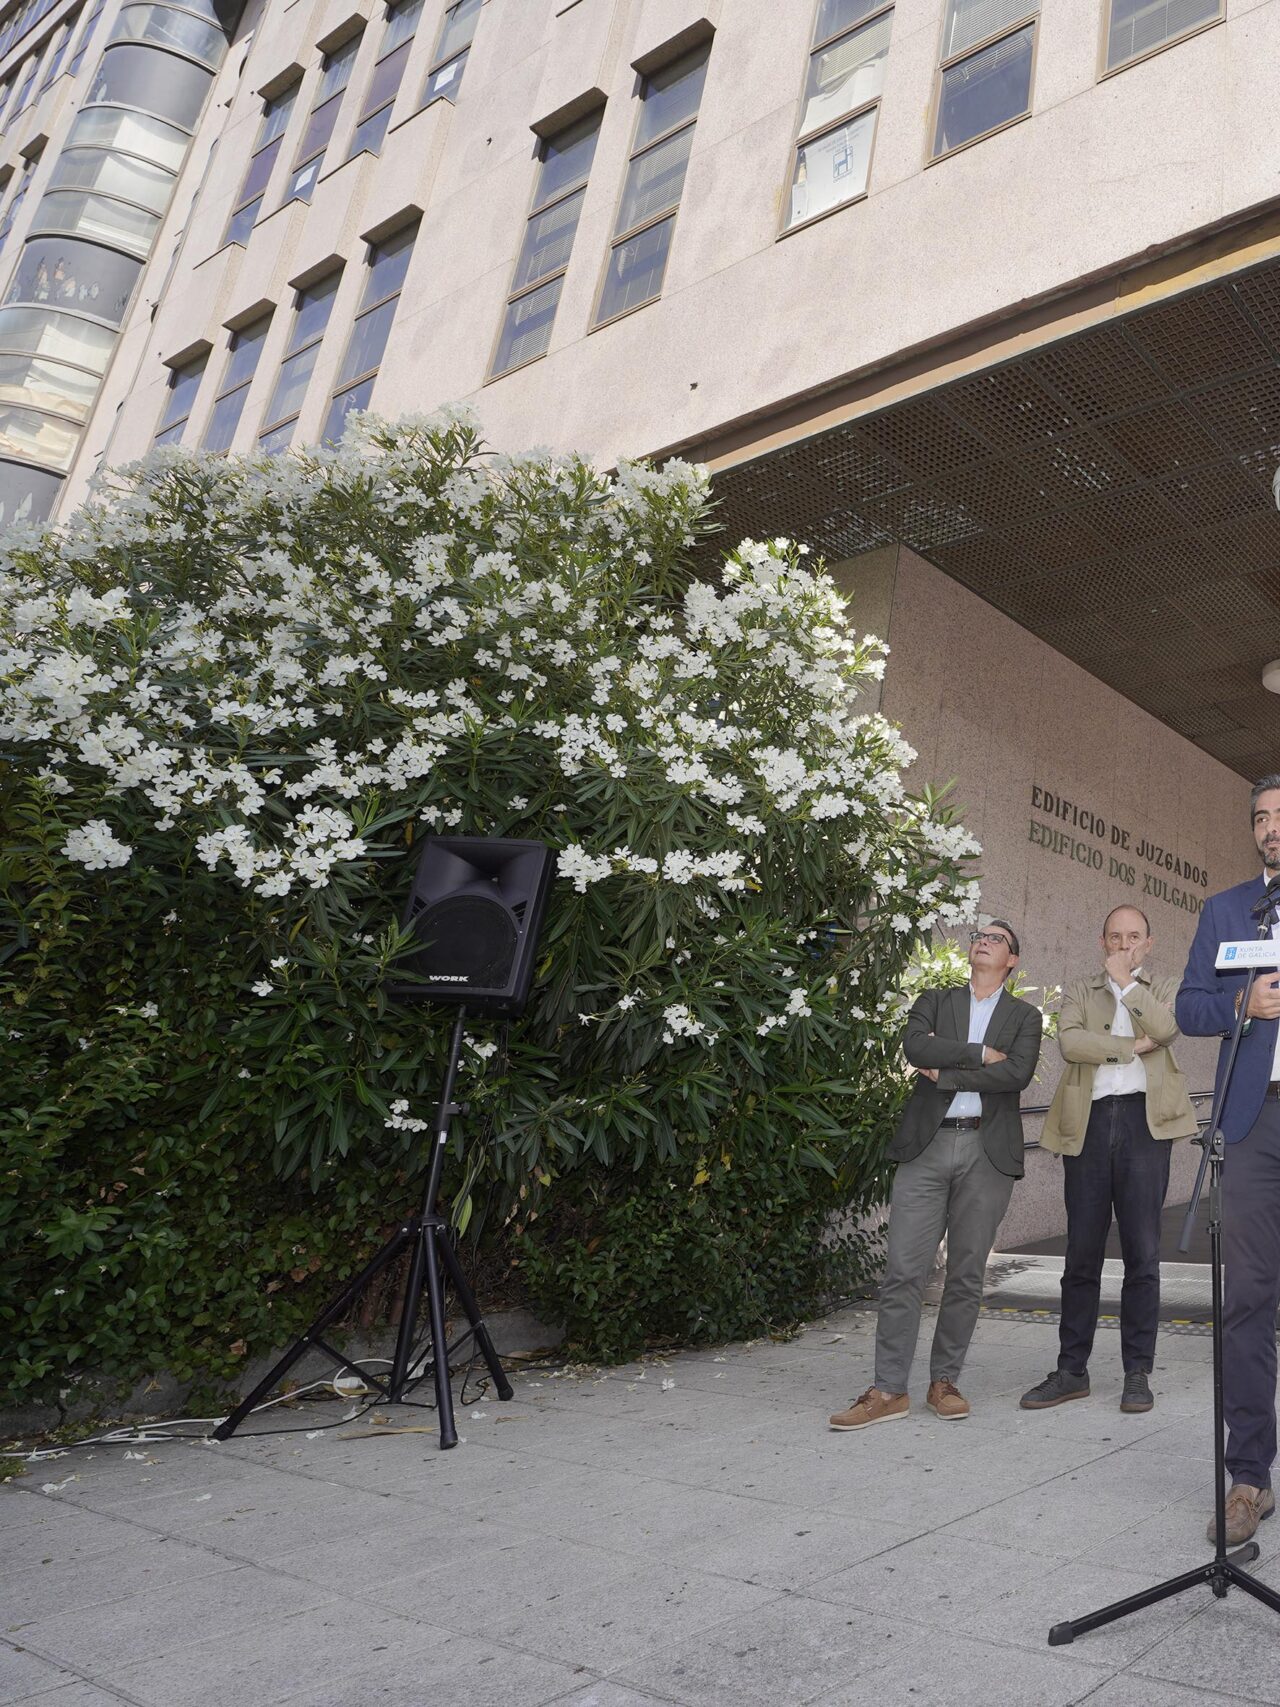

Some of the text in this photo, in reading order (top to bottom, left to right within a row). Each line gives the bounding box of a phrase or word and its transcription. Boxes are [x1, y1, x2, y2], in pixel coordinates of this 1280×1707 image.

[1028, 819, 1205, 914] EDIFICIO DOS XULGADO
[1031, 785, 1208, 888] EDIFICIO DE JUZGADOS
